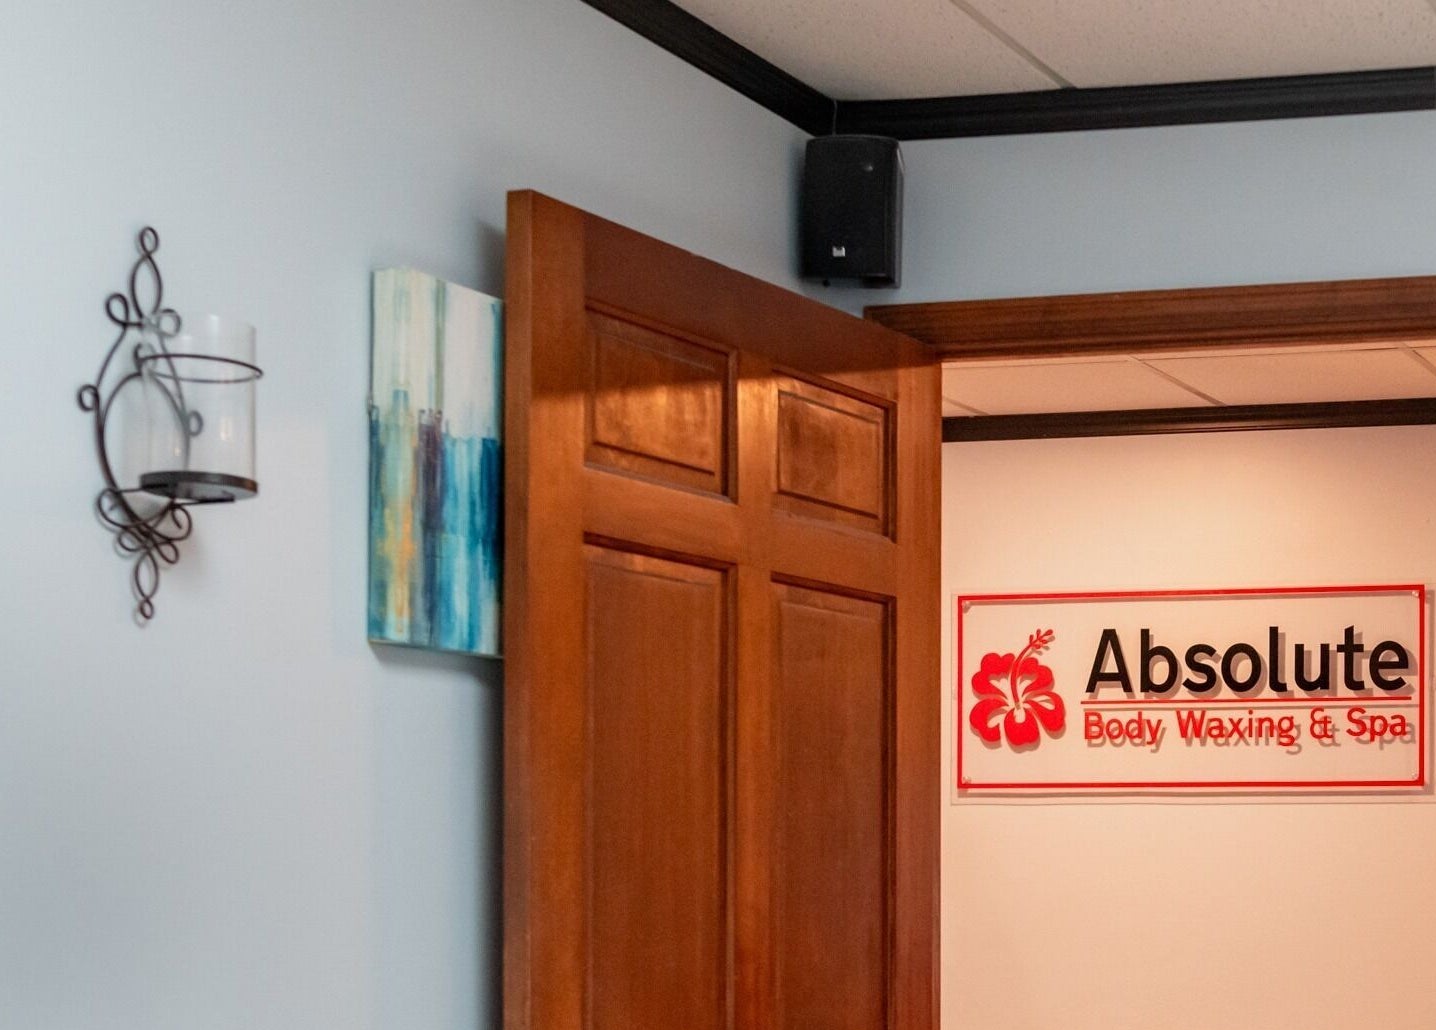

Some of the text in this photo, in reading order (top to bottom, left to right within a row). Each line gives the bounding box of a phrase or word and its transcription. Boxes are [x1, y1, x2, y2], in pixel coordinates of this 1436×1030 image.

[1085, 625, 1409, 694] Absolute
[1084, 706, 1407, 747] Body Waxing & Spa
